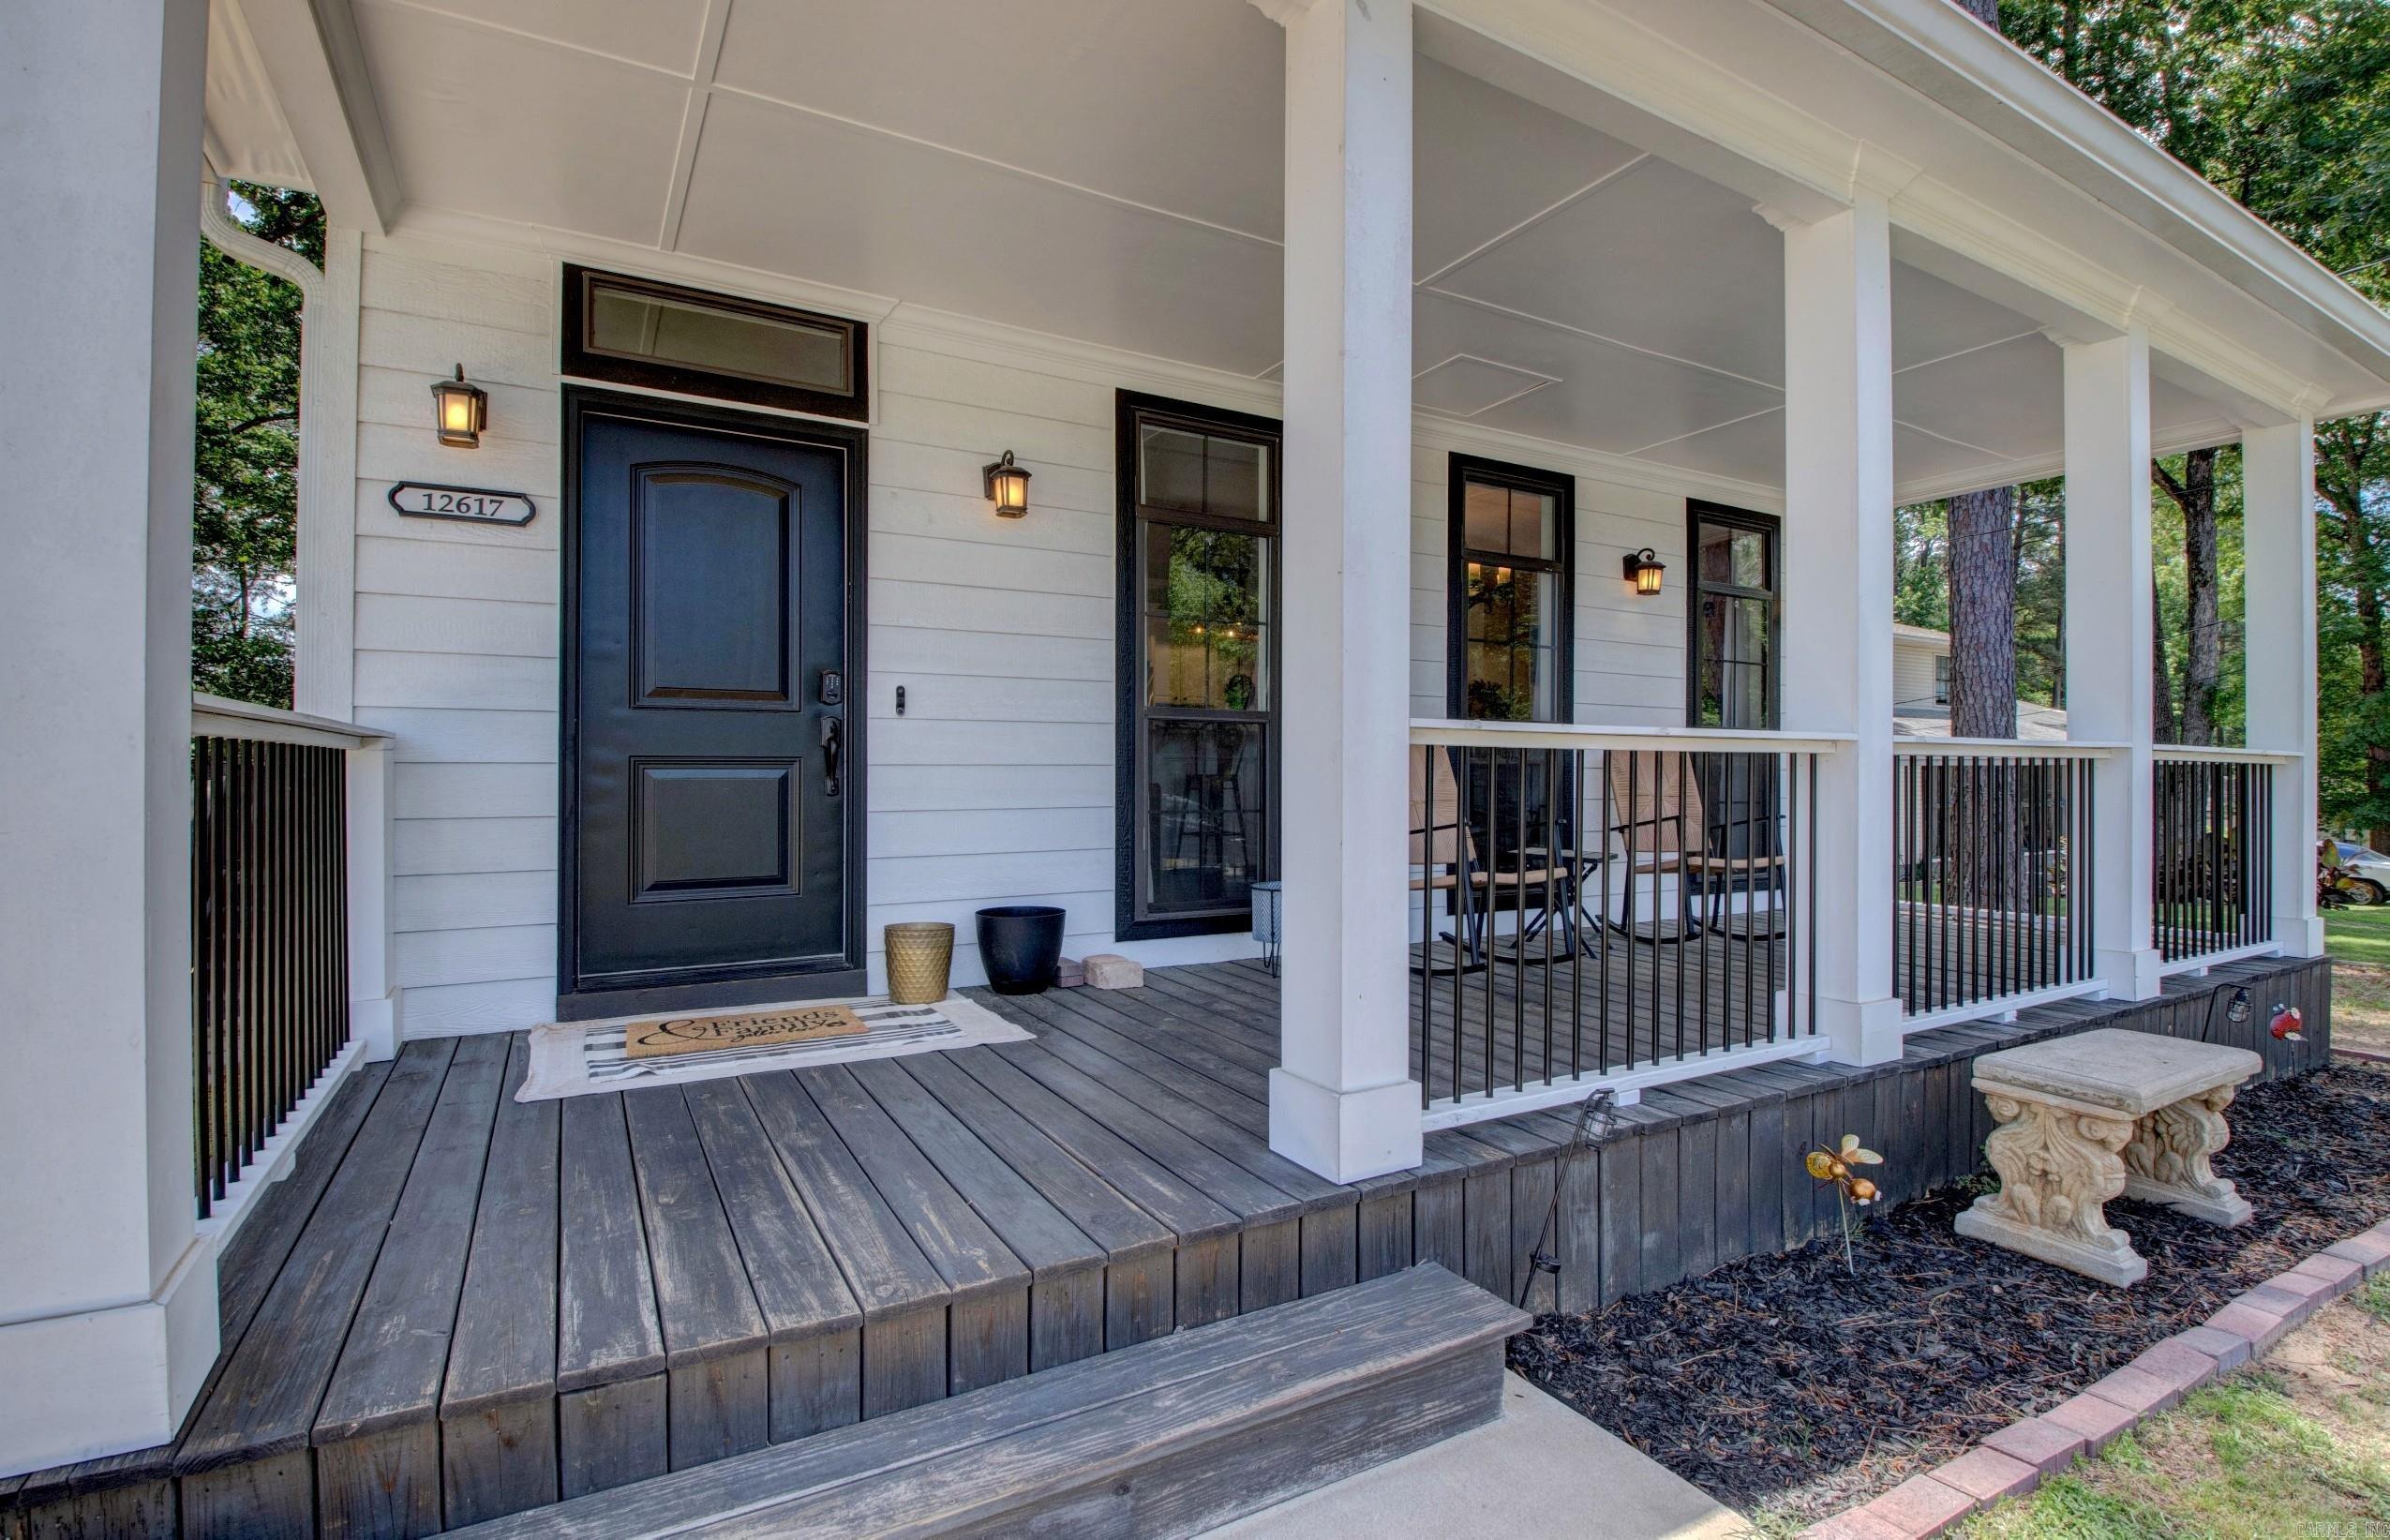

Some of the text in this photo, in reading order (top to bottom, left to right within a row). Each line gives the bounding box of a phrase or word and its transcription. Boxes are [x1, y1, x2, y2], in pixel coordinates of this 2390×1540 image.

[422, 492, 504, 516] 12617
[711, 1011, 839, 1030] Friends
[713, 1018, 828, 1037] Family
